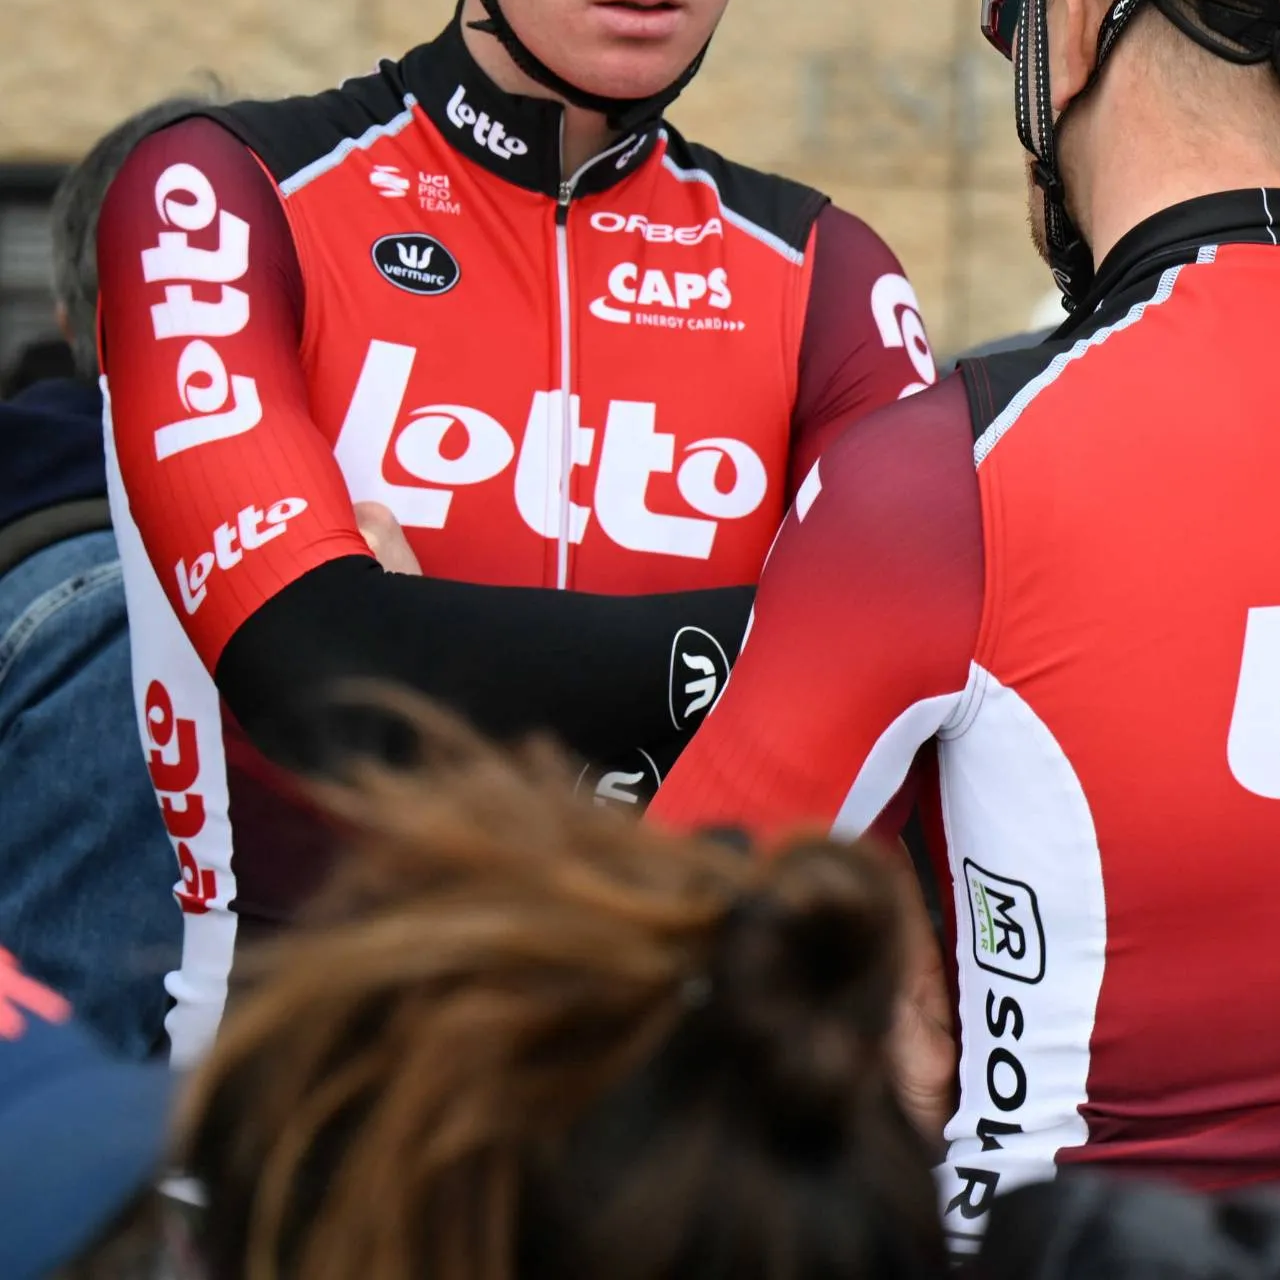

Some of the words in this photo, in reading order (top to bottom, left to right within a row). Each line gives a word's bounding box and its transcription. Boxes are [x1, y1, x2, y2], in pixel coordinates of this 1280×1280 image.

[418, 184, 451, 198] PRO
[419, 171, 449, 188] UCI
[419, 197, 461, 216] TEAM
[590, 211, 723, 246] ORBEA
[384, 262, 445, 287] vermarc
[607, 261, 732, 311] CAPS
[635, 313, 684, 330] ENERGY
[687, 317, 722, 332] CARD
[984, 886, 1026, 960] MR
[944, 988, 1027, 1220] SOLR
